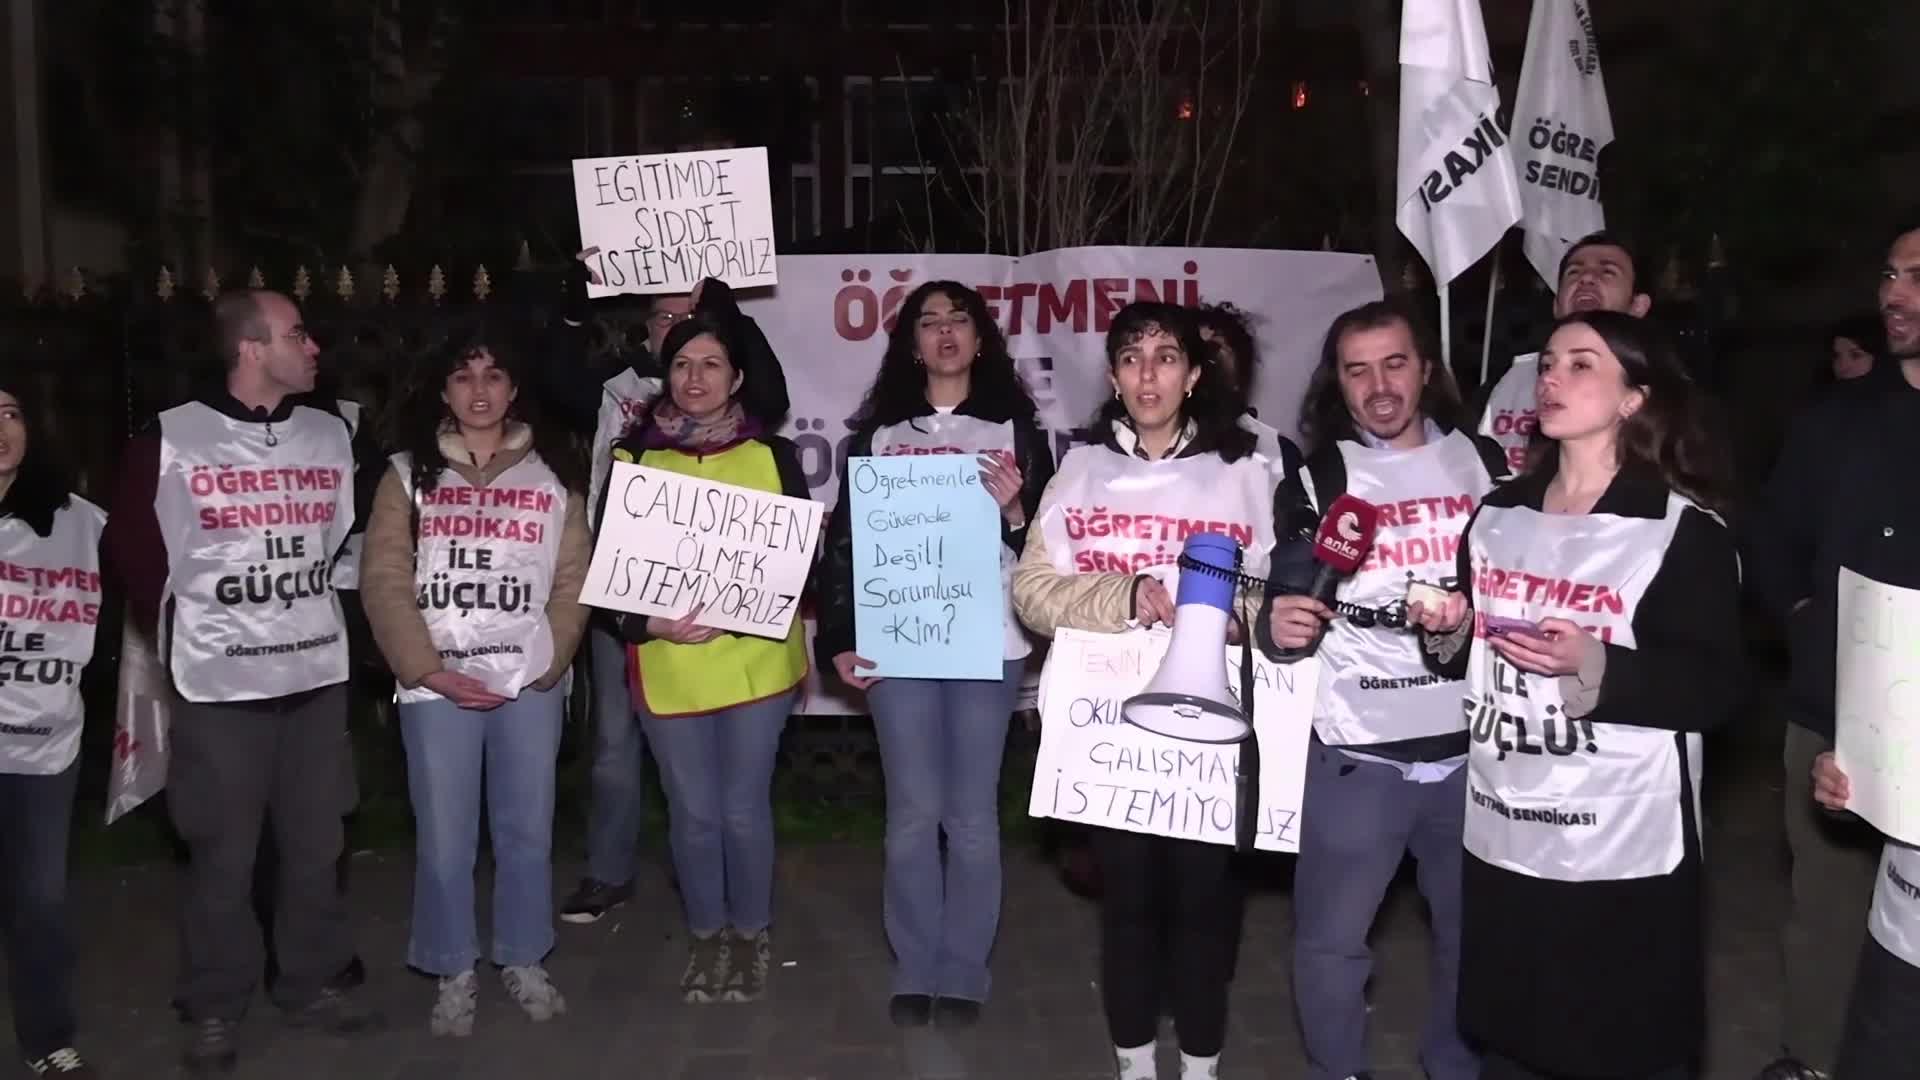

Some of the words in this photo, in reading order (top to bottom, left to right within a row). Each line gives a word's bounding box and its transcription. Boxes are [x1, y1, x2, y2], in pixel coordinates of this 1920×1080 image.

[594, 158, 735, 206] EĞİTİMDE
[191, 464, 343, 497] ÖĞRETMEN
[855, 458, 977, 500] Öğretmenle
[421, 485, 553, 514] ĞRETMEN
[1376, 494, 1475, 528] RETM
[867, 503, 952, 532] Güvende
[265, 529, 305, 560] İLE
[449, 540, 493, 570] İLE
[676, 531, 768, 584] ÖLMEK
[873, 535, 944, 571] Değil!
[1323, 535, 1360, 557] anka
[215, 560, 335, 610] GÜÇLÜ!
[605, 548, 796, 626] İSTEMİYORUZ
[858, 572, 974, 609] Sorumlusu
[881, 603, 957, 646] Kim?
[225, 642, 295, 657] ÖĞRETMEN
[1360, 674, 1439, 690] ÖĞRETMEN
[1053, 768, 1298, 844] İSTEMİYOUZ
[1512, 807, 1598, 826] SENDİKASI
